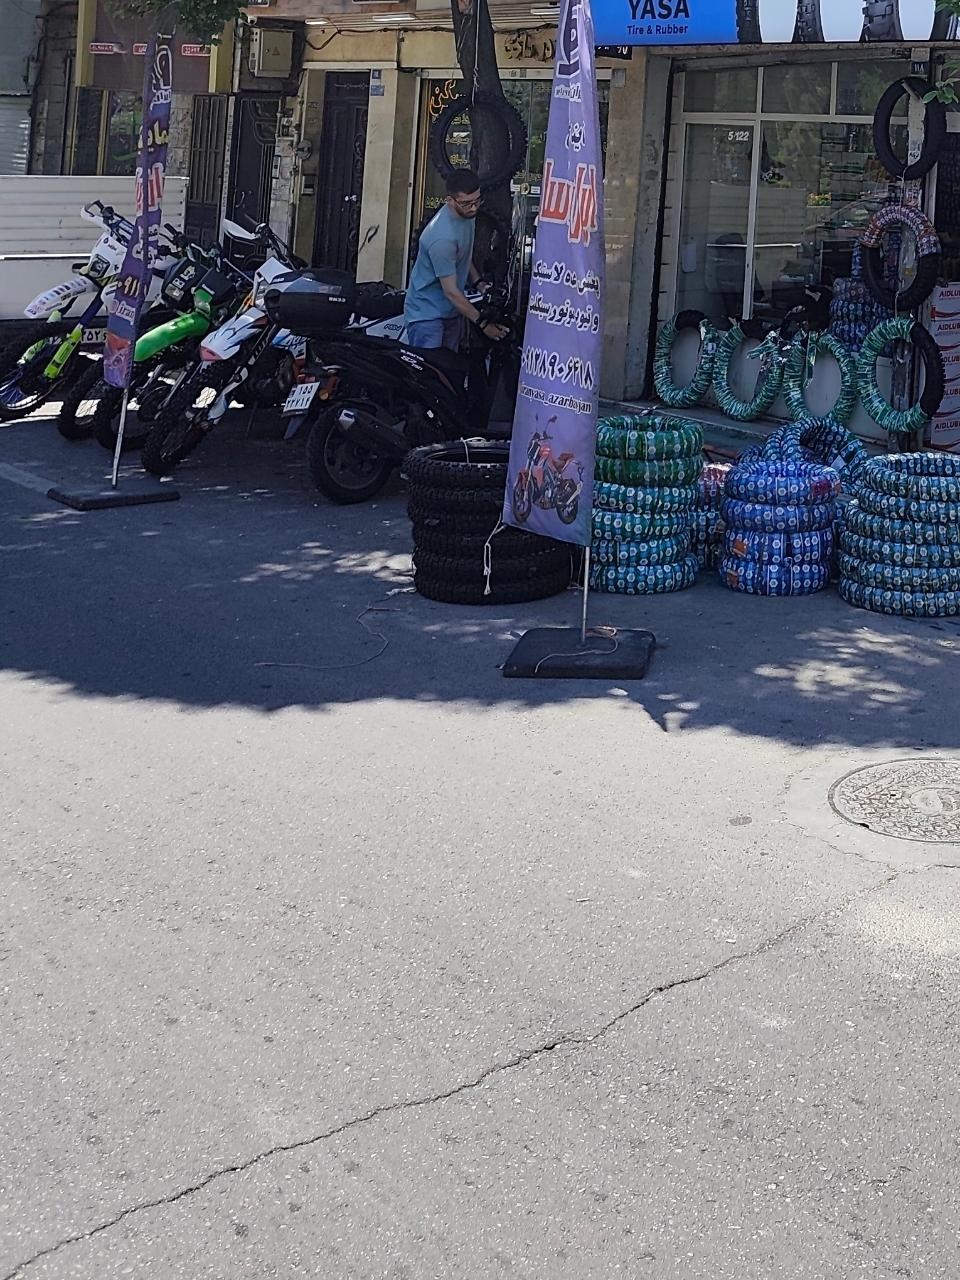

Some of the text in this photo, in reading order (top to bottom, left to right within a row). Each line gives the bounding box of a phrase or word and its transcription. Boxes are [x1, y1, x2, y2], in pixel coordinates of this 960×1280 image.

[627, 24, 689, 35] Tire & Rubber
